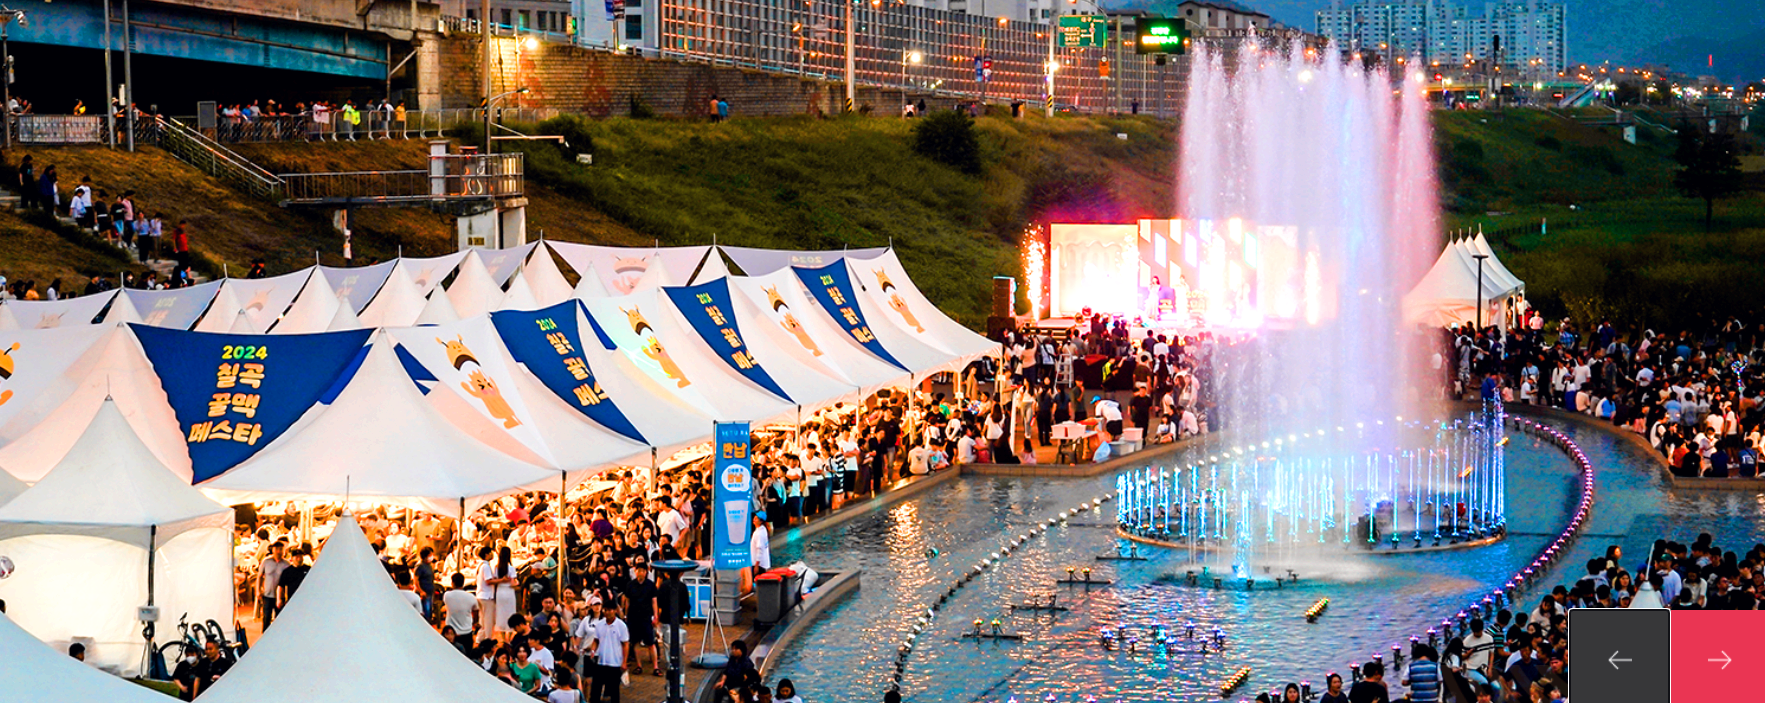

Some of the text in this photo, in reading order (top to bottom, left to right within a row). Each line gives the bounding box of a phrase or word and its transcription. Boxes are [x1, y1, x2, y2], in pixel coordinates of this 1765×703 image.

[696, 292, 713, 304] 2024
[536, 317, 557, 331] 2024
[221, 345, 268, 360] 2024
[546, 332, 575, 355] 칠곡
[216, 362, 265, 389] 칠곡
[207, 392, 260, 418] 꿀맥
[188, 420, 263, 446] 페스타
[723, 442, 747, 459] 반납
